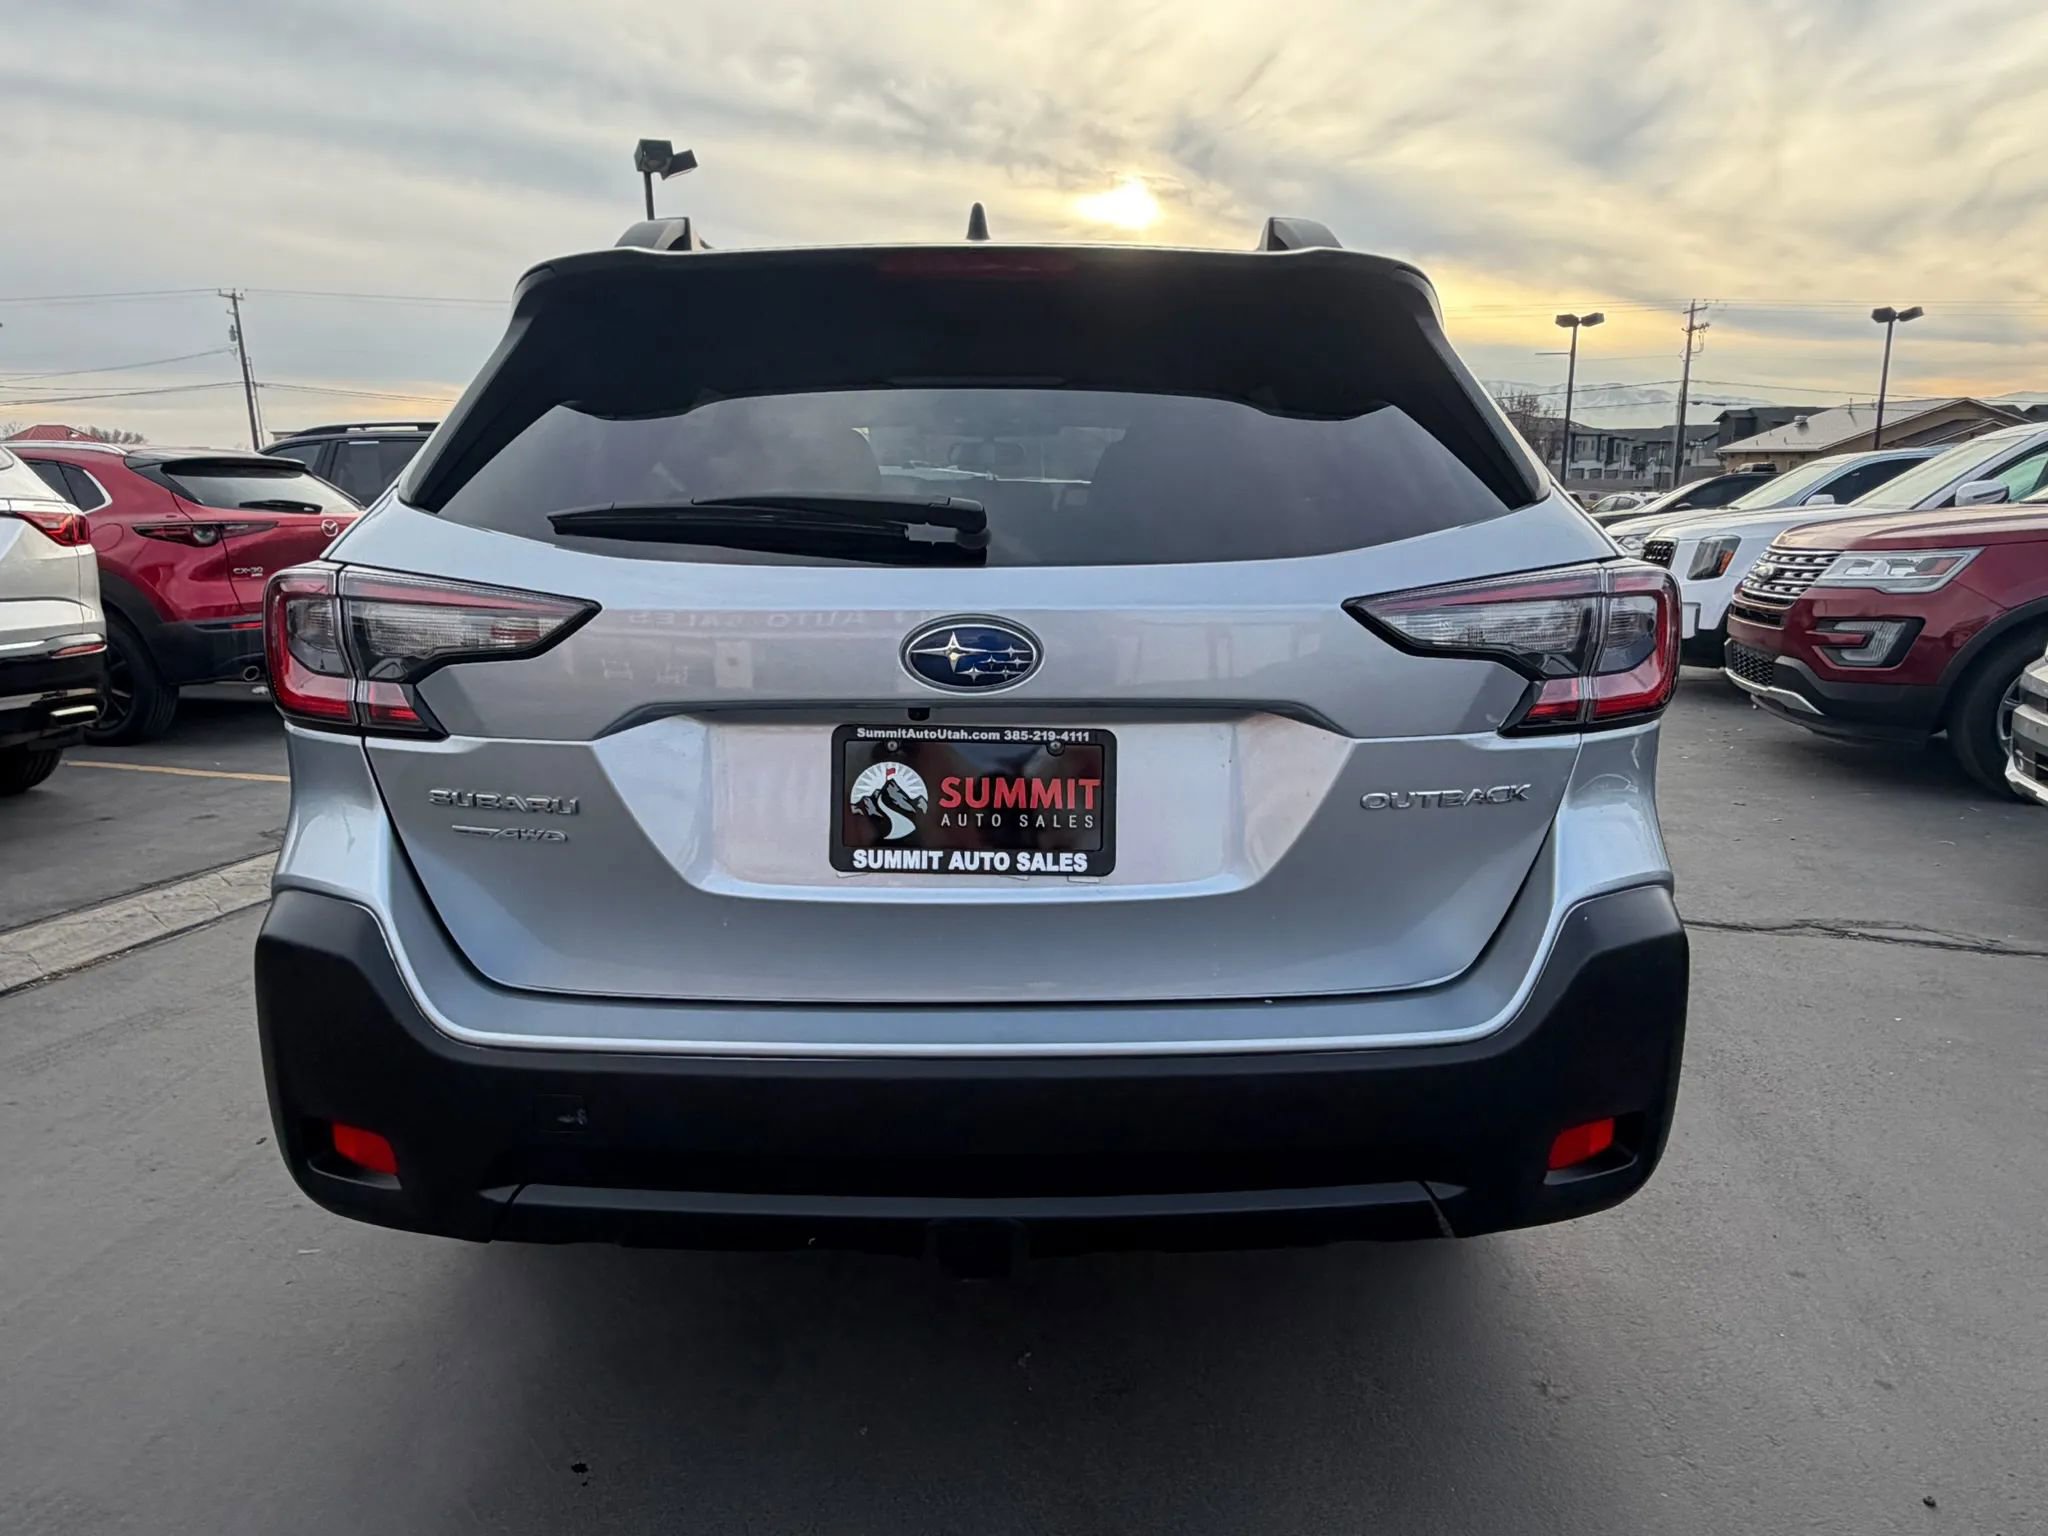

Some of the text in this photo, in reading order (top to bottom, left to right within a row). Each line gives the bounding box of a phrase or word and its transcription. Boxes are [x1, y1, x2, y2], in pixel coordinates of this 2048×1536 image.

[856, 727, 1090, 742] SummitAutoUtah.com 385-219-4111
[429, 787, 580, 816] SUBARU
[938, 776, 1101, 810] SUMMIT
[1360, 783, 1532, 811] OUTBACK
[940, 813, 1094, 829] AUTO SALES
[490, 826, 569, 842] AWD
[852, 849, 1088, 873] SUMMIT AUTO SALES
